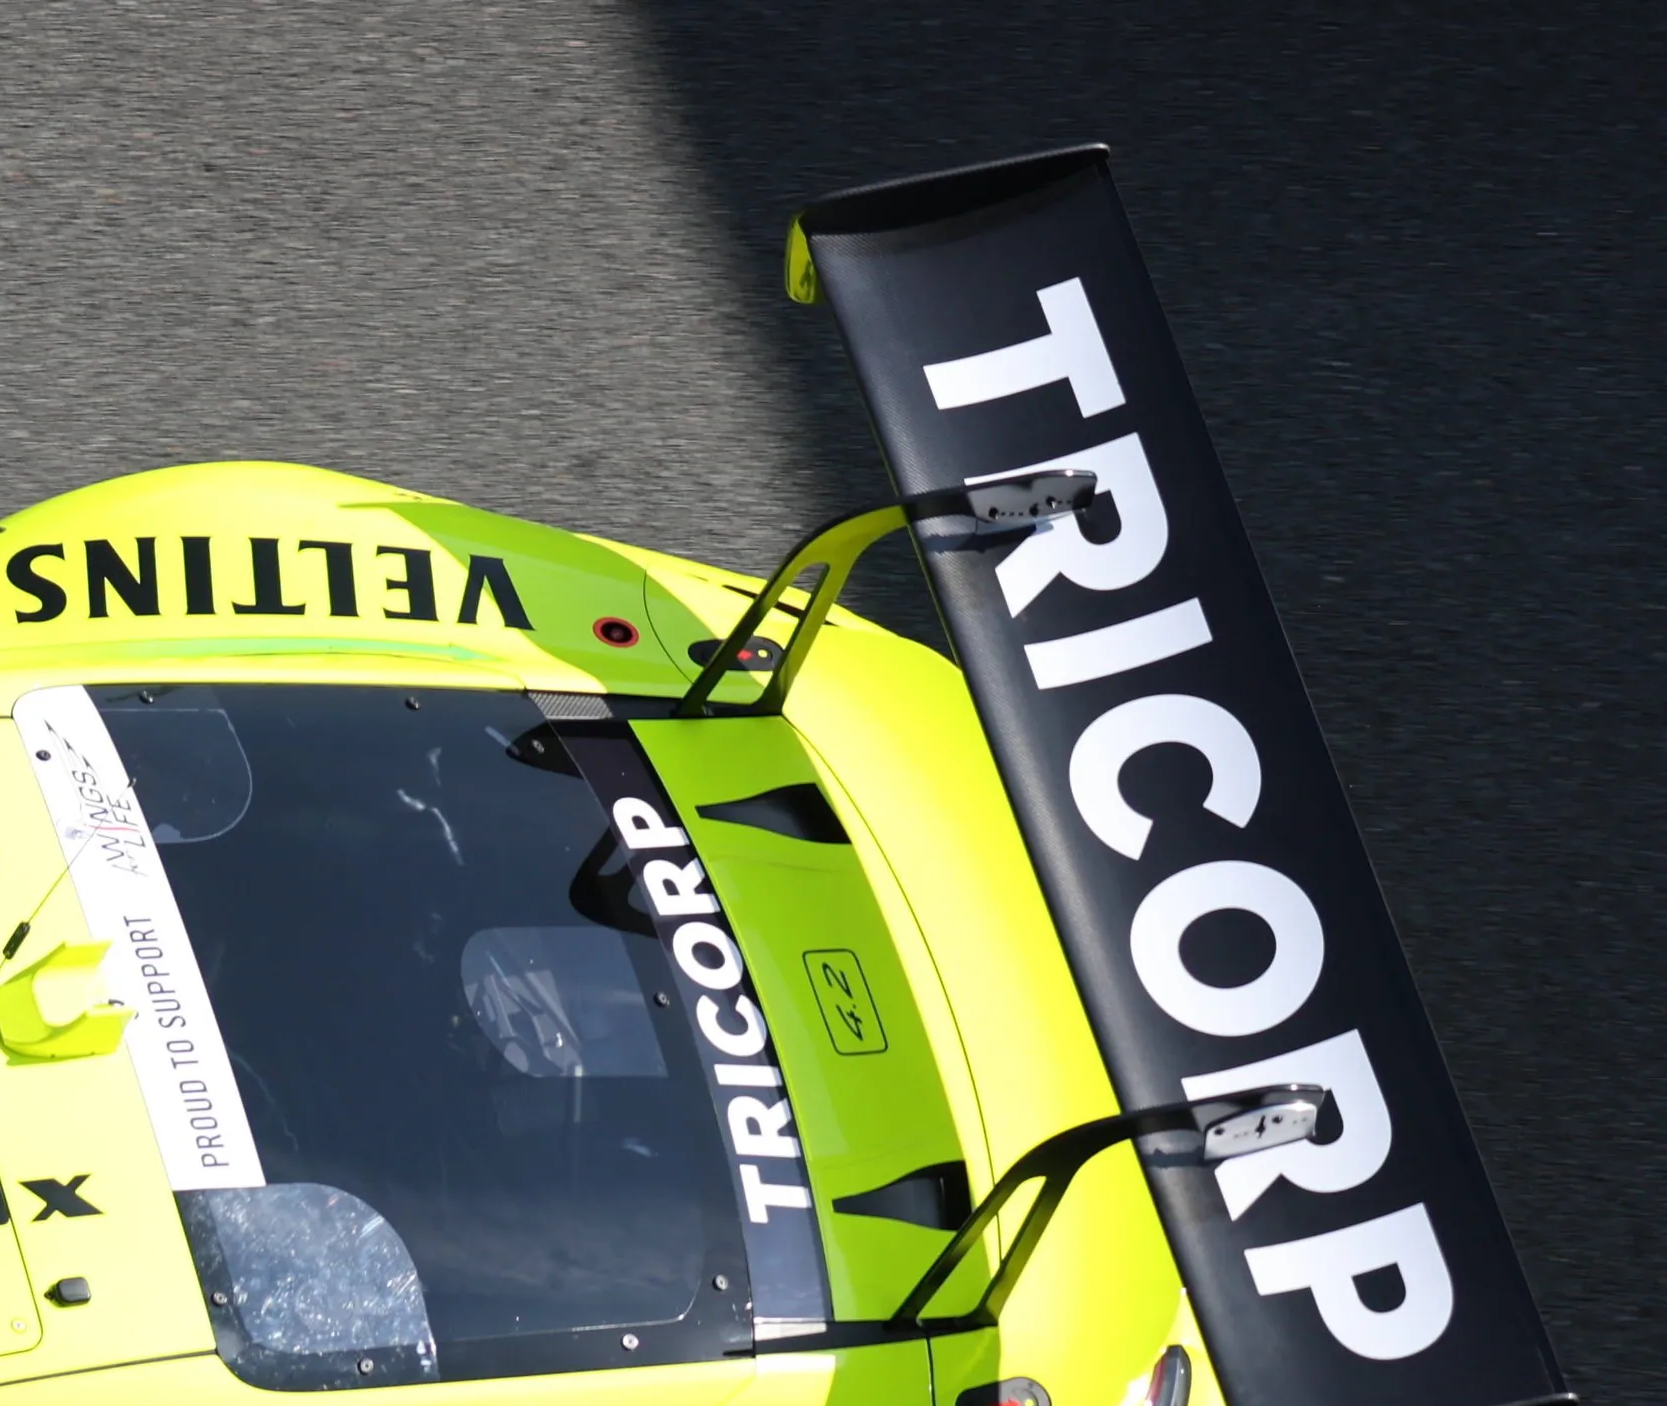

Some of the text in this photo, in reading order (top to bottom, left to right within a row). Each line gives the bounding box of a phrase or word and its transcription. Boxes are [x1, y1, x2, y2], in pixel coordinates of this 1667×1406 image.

[6, 535, 536, 632] VELTINS
[923, 277, 1454, 1360] TRICORP
[123, 916, 229, 1167] PROUD TO SUPPORT
[613, 797, 812, 1224] TRICORP
